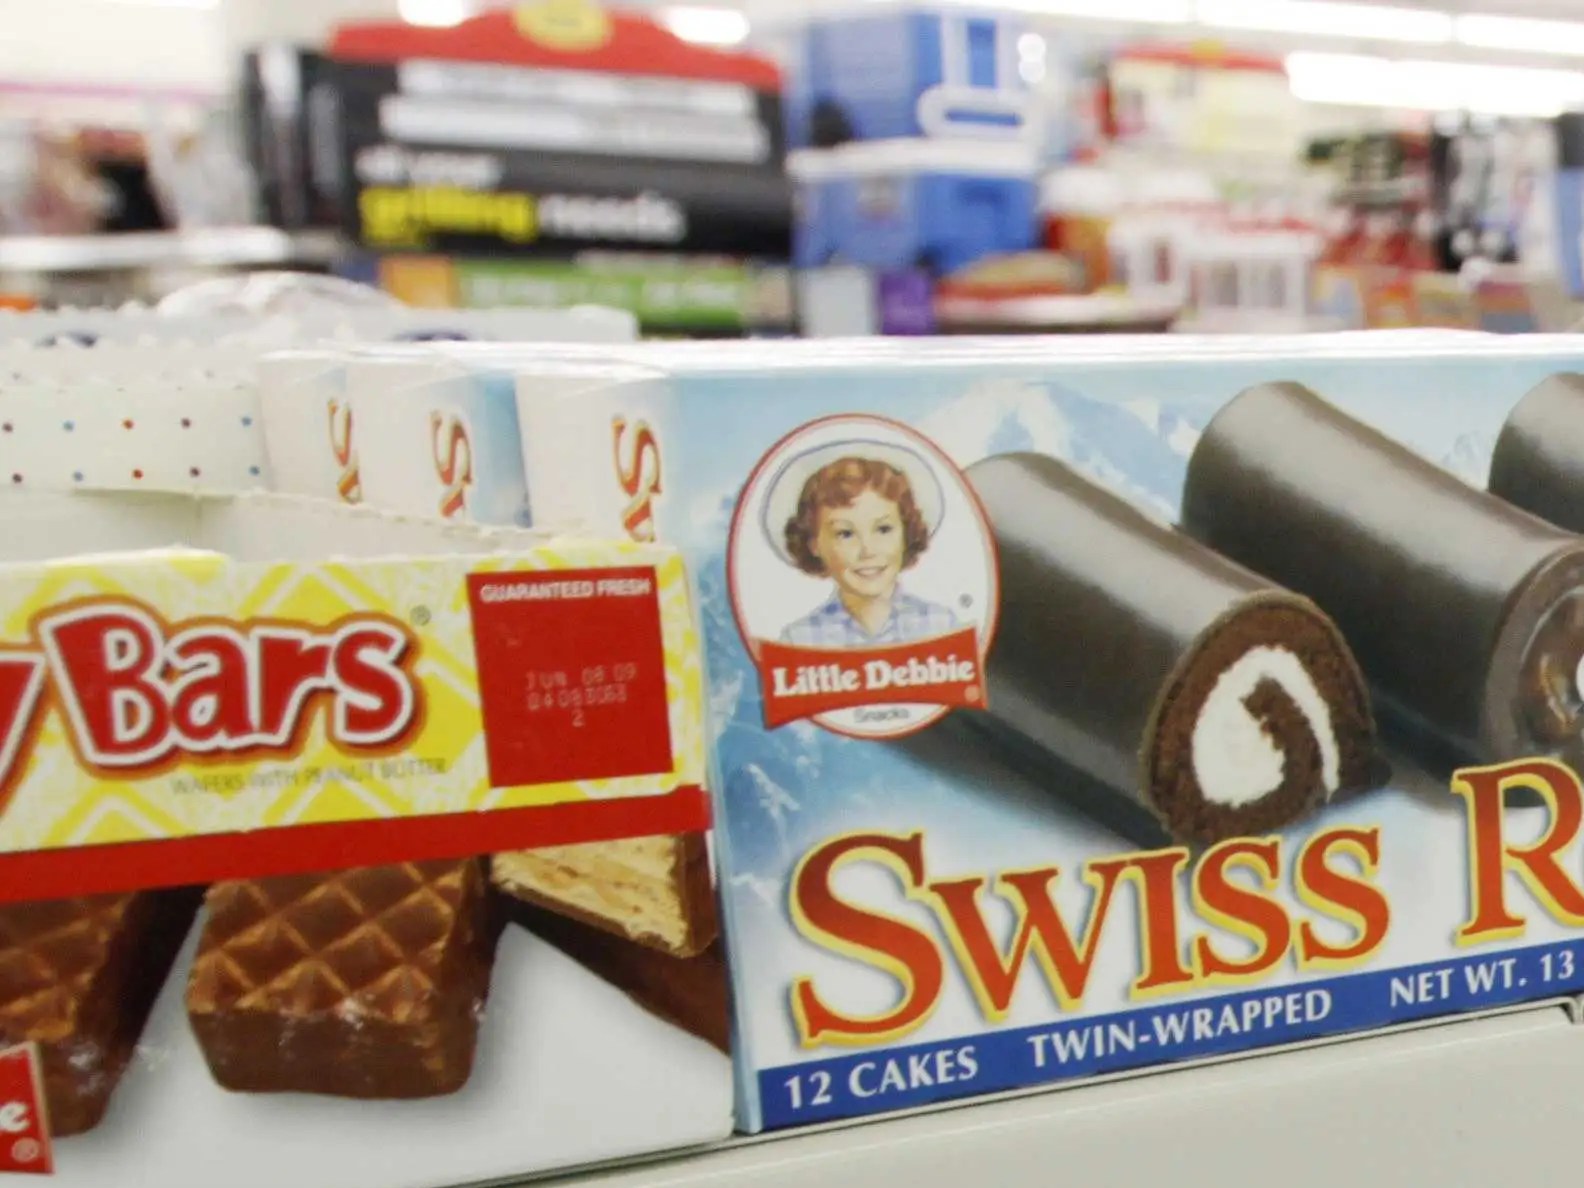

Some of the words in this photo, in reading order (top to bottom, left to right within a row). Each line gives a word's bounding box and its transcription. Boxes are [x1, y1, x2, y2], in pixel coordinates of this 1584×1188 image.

[480, 580, 594, 604] GUARANTEED
[596, 577, 651, 597] FRESH
[40, 604, 414, 765] Bars
[772, 663, 861, 698] Little
[864, 654, 976, 691] Debbie
[784, 1069, 835, 1110] 12
[848, 1044, 979, 1098] CAKES
[1028, 987, 1333, 1069] TWIN-WRAPPED
[1391, 967, 1451, 1008] NET
[1465, 949, 1528, 993] WT.
[1539, 943, 1574, 981] 13
